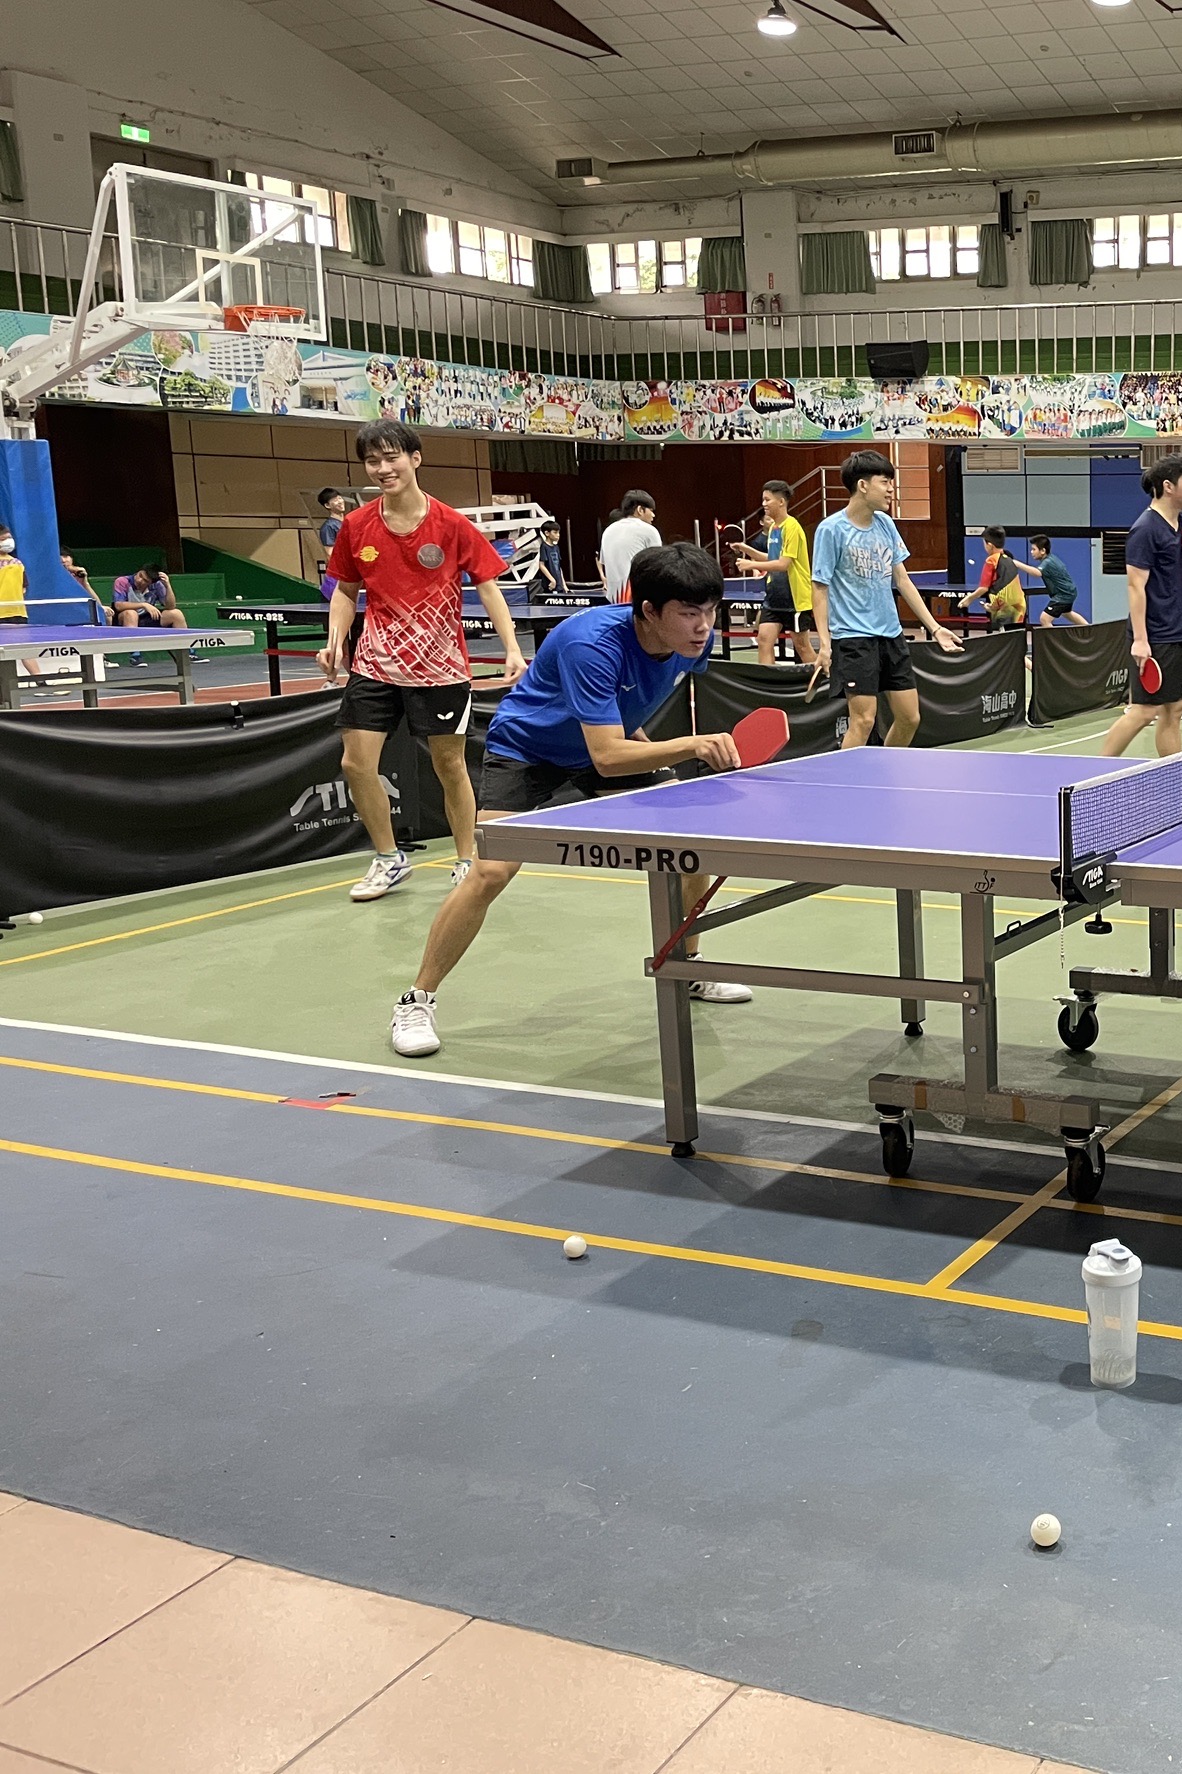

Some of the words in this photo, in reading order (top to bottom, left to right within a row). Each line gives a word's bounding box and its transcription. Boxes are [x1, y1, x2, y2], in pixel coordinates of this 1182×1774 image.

[848, 546, 872, 559] NEW
[851, 556, 882, 572] TAIPEI
[461, 620, 482, 629] TIGA
[190, 637, 226, 648] STIGA
[39, 646, 80, 657] STIGA
[980, 689, 1017, 715] 海山高中
[289, 773, 401, 817] STIA
[293, 820, 320, 833] Table
[321, 814, 351, 828] Tennis
[555, 842, 701, 875] 7190-PRO
[1082, 864, 1104, 886] STIGA
